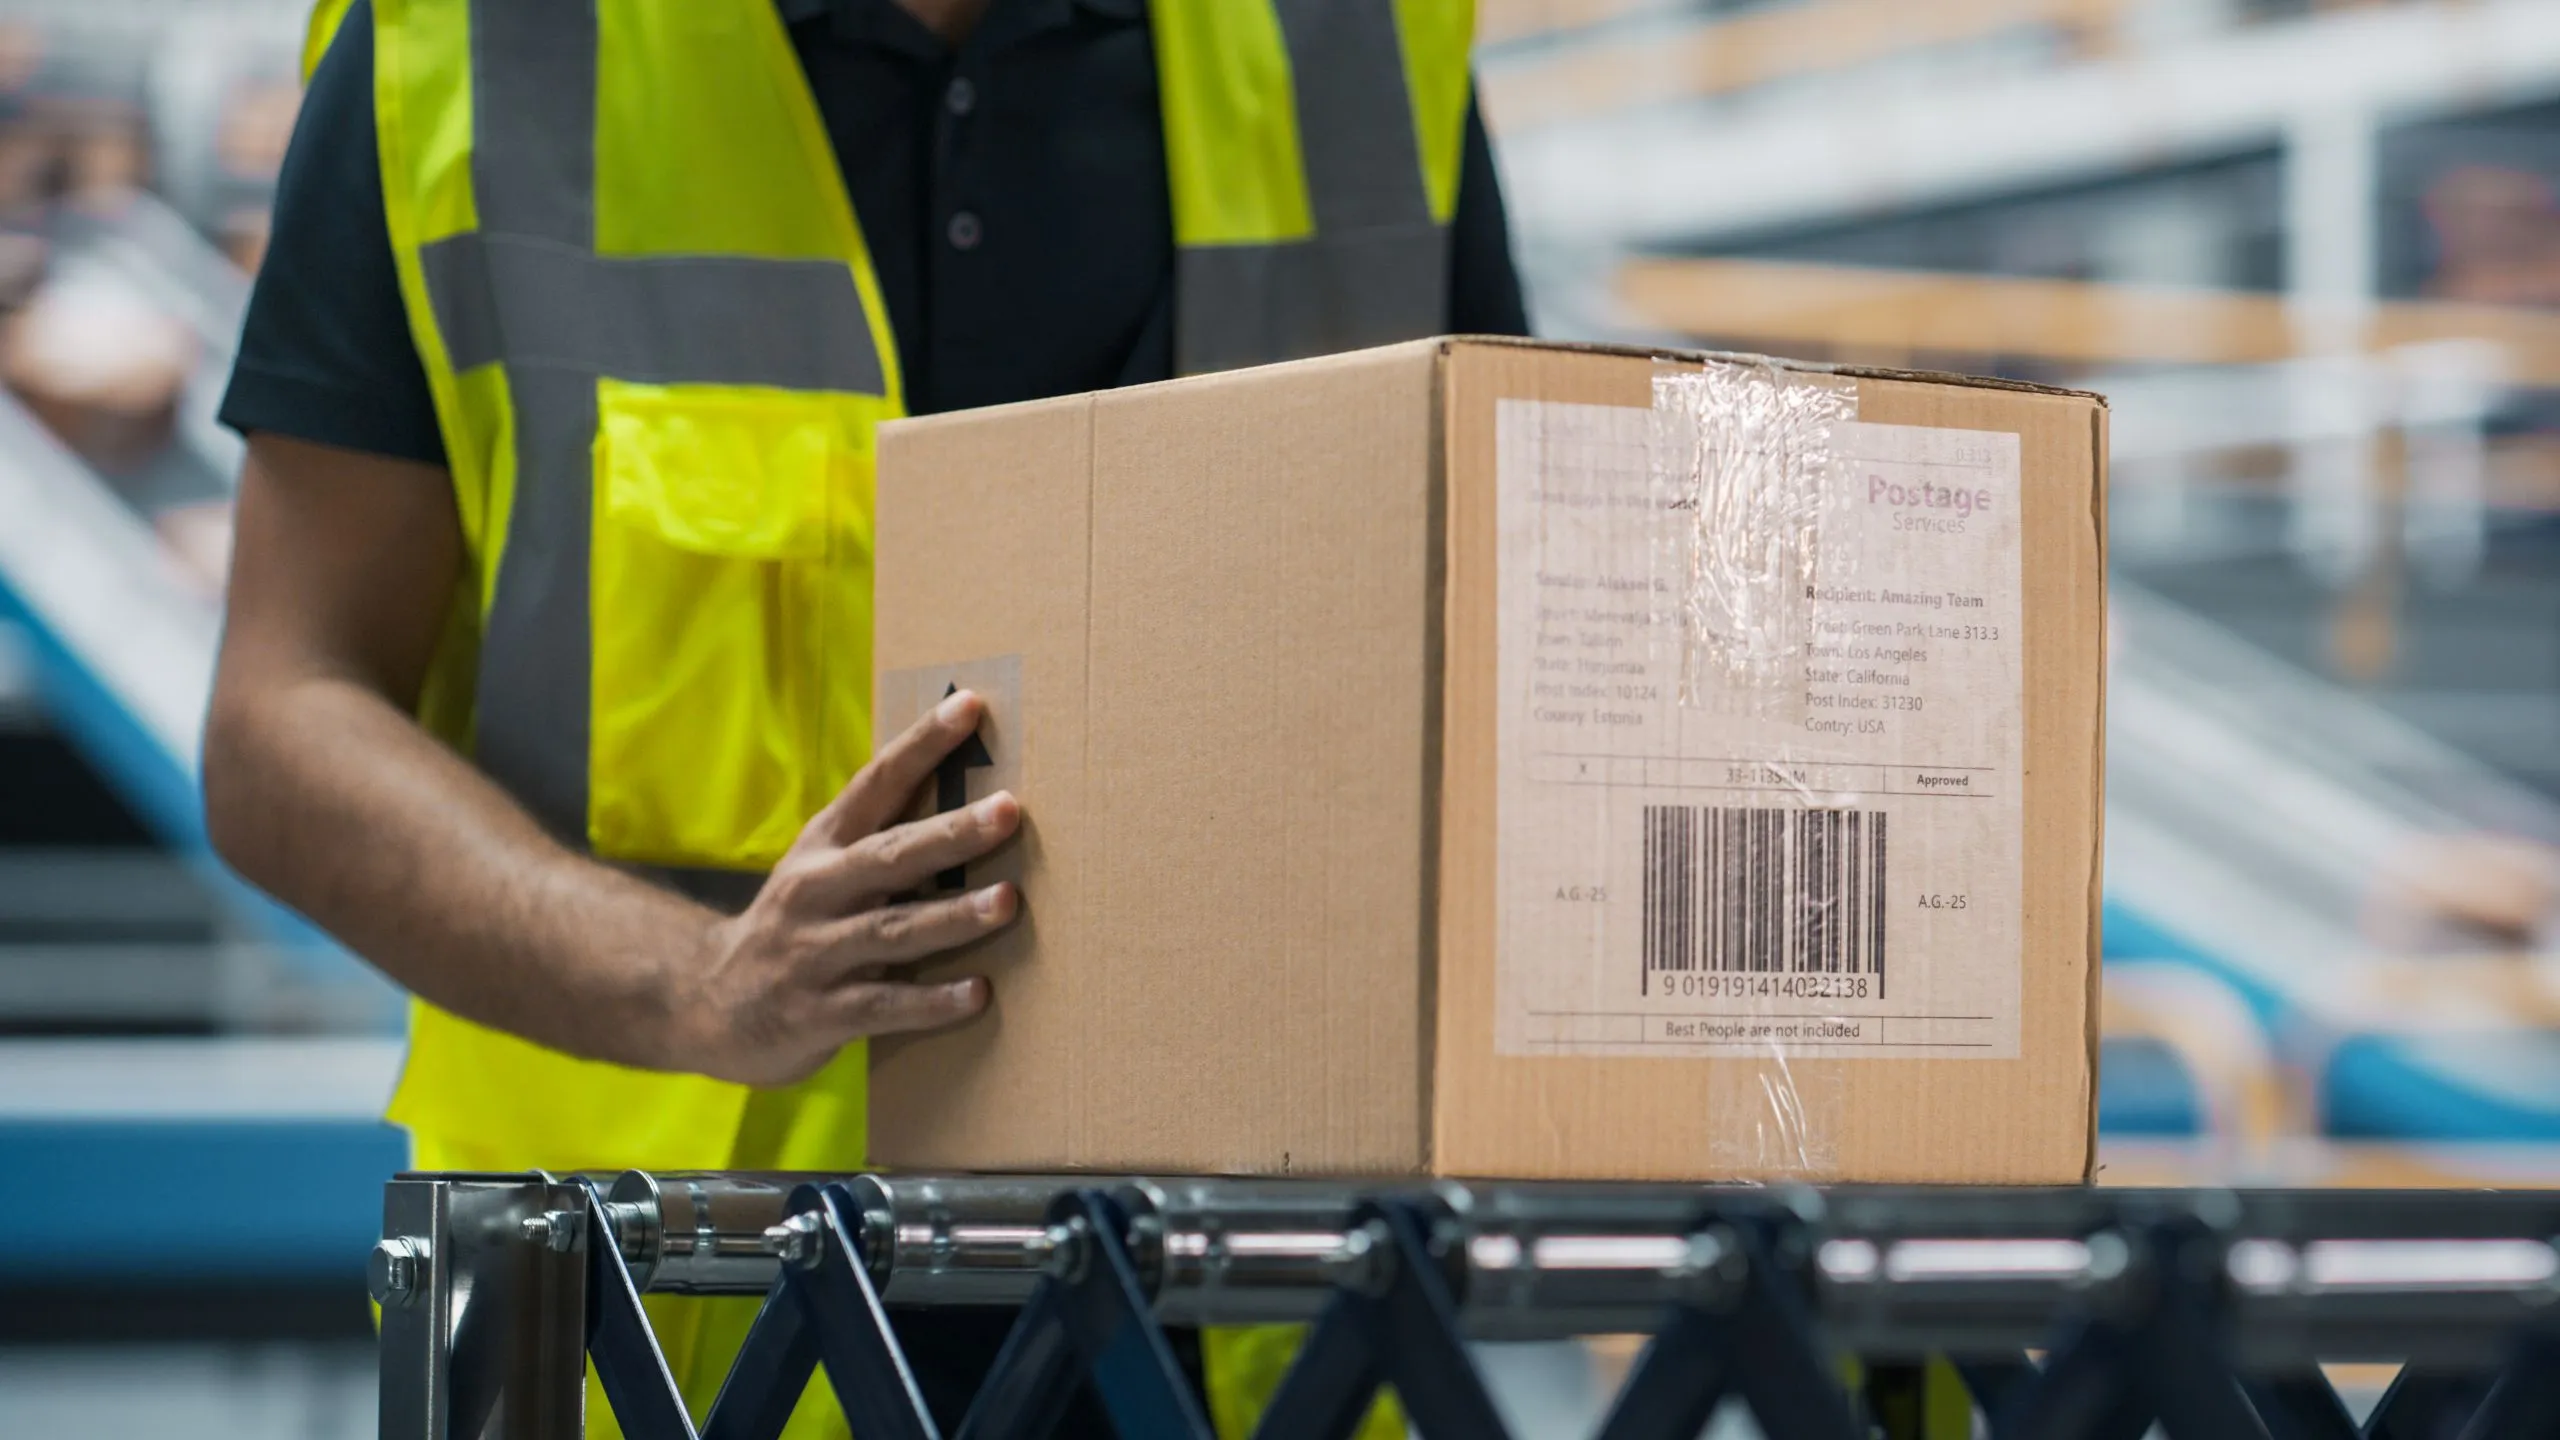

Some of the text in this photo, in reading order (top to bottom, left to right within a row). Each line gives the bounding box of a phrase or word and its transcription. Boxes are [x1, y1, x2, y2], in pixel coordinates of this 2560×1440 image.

[1868, 473, 1992, 519] Postage
[1892, 511, 1966, 534] Services
[1805, 585, 1985, 609] Recipient: Amazing Team
[1852, 620, 1892, 637] Green
[1897, 623, 1926, 638] Park
[1929, 624, 1960, 640] Lane
[1963, 625, 2000, 642] 313.3
[1805, 642, 1928, 664] Town: Los Angeles
[1804, 667, 1911, 687] State: California
[1804, 692, 1923, 712] Post Index: 31230
[1804, 717, 1887, 737] Contry: USA
[1916, 773, 1970, 787] Approved
[1554, 886, 1608, 903] A.G.-25
[1917, 894, 1967, 909] A.G.-25
[1662, 976, 1870, 999] 9 019191414032138
[1665, 1022, 1861, 1041] Best People are not included
